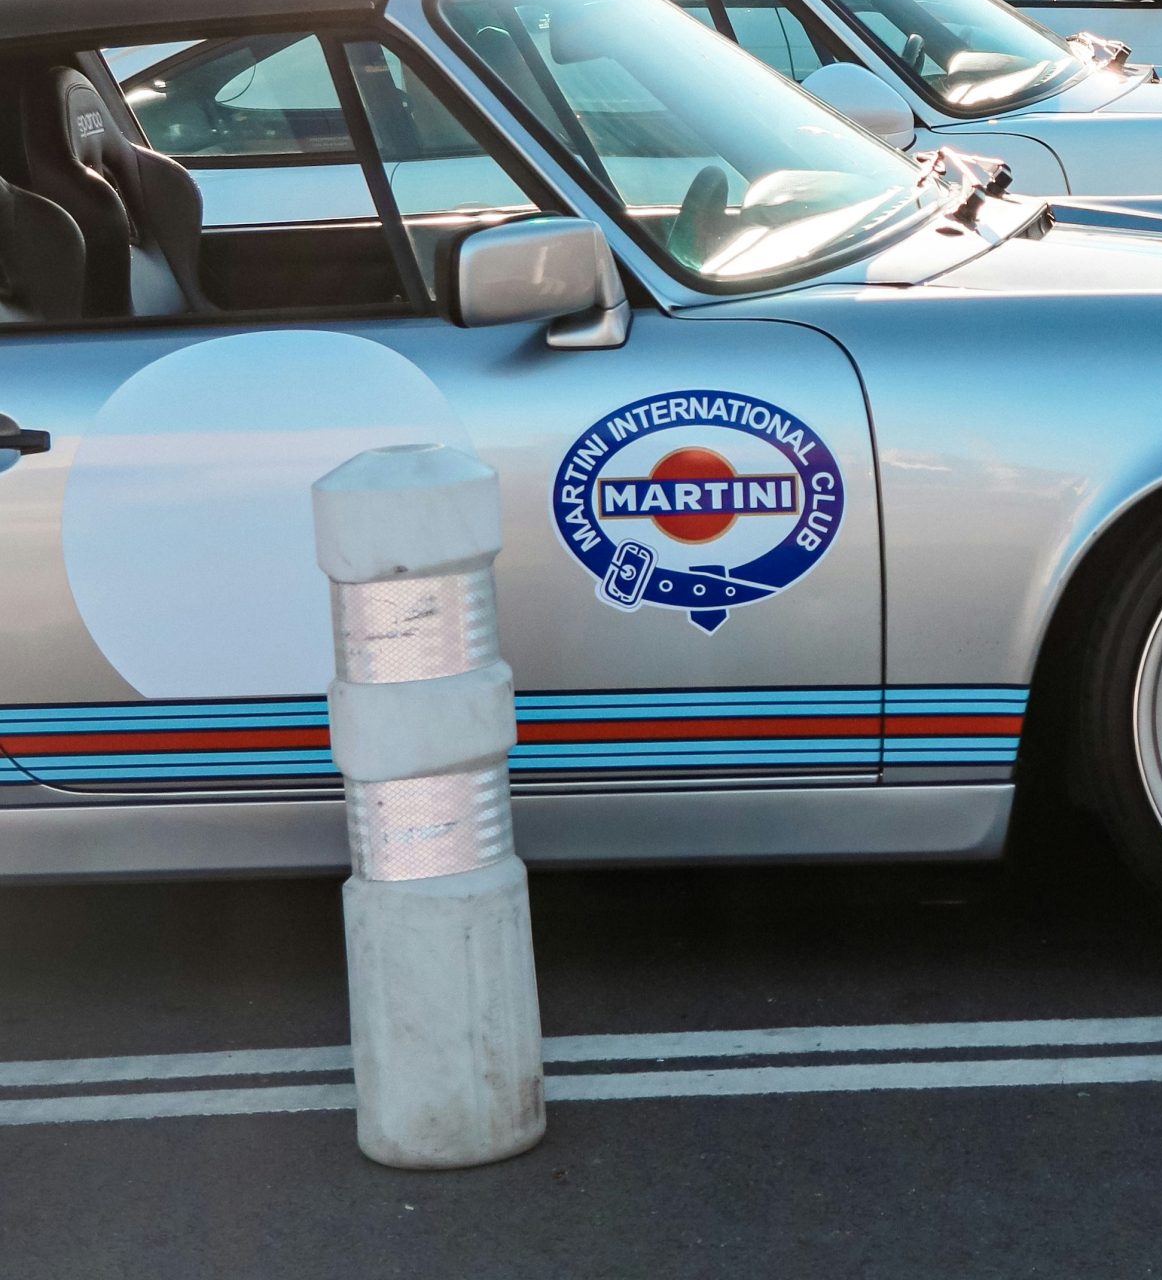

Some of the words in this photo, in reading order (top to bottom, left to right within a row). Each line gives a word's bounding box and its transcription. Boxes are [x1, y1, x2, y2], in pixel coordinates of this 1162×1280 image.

[561, 432, 609, 553] MARTINI
[607, 396, 816, 466] INTERNATIONAL
[796, 471, 836, 553] CLUB
[604, 480, 793, 512] MARTINI
